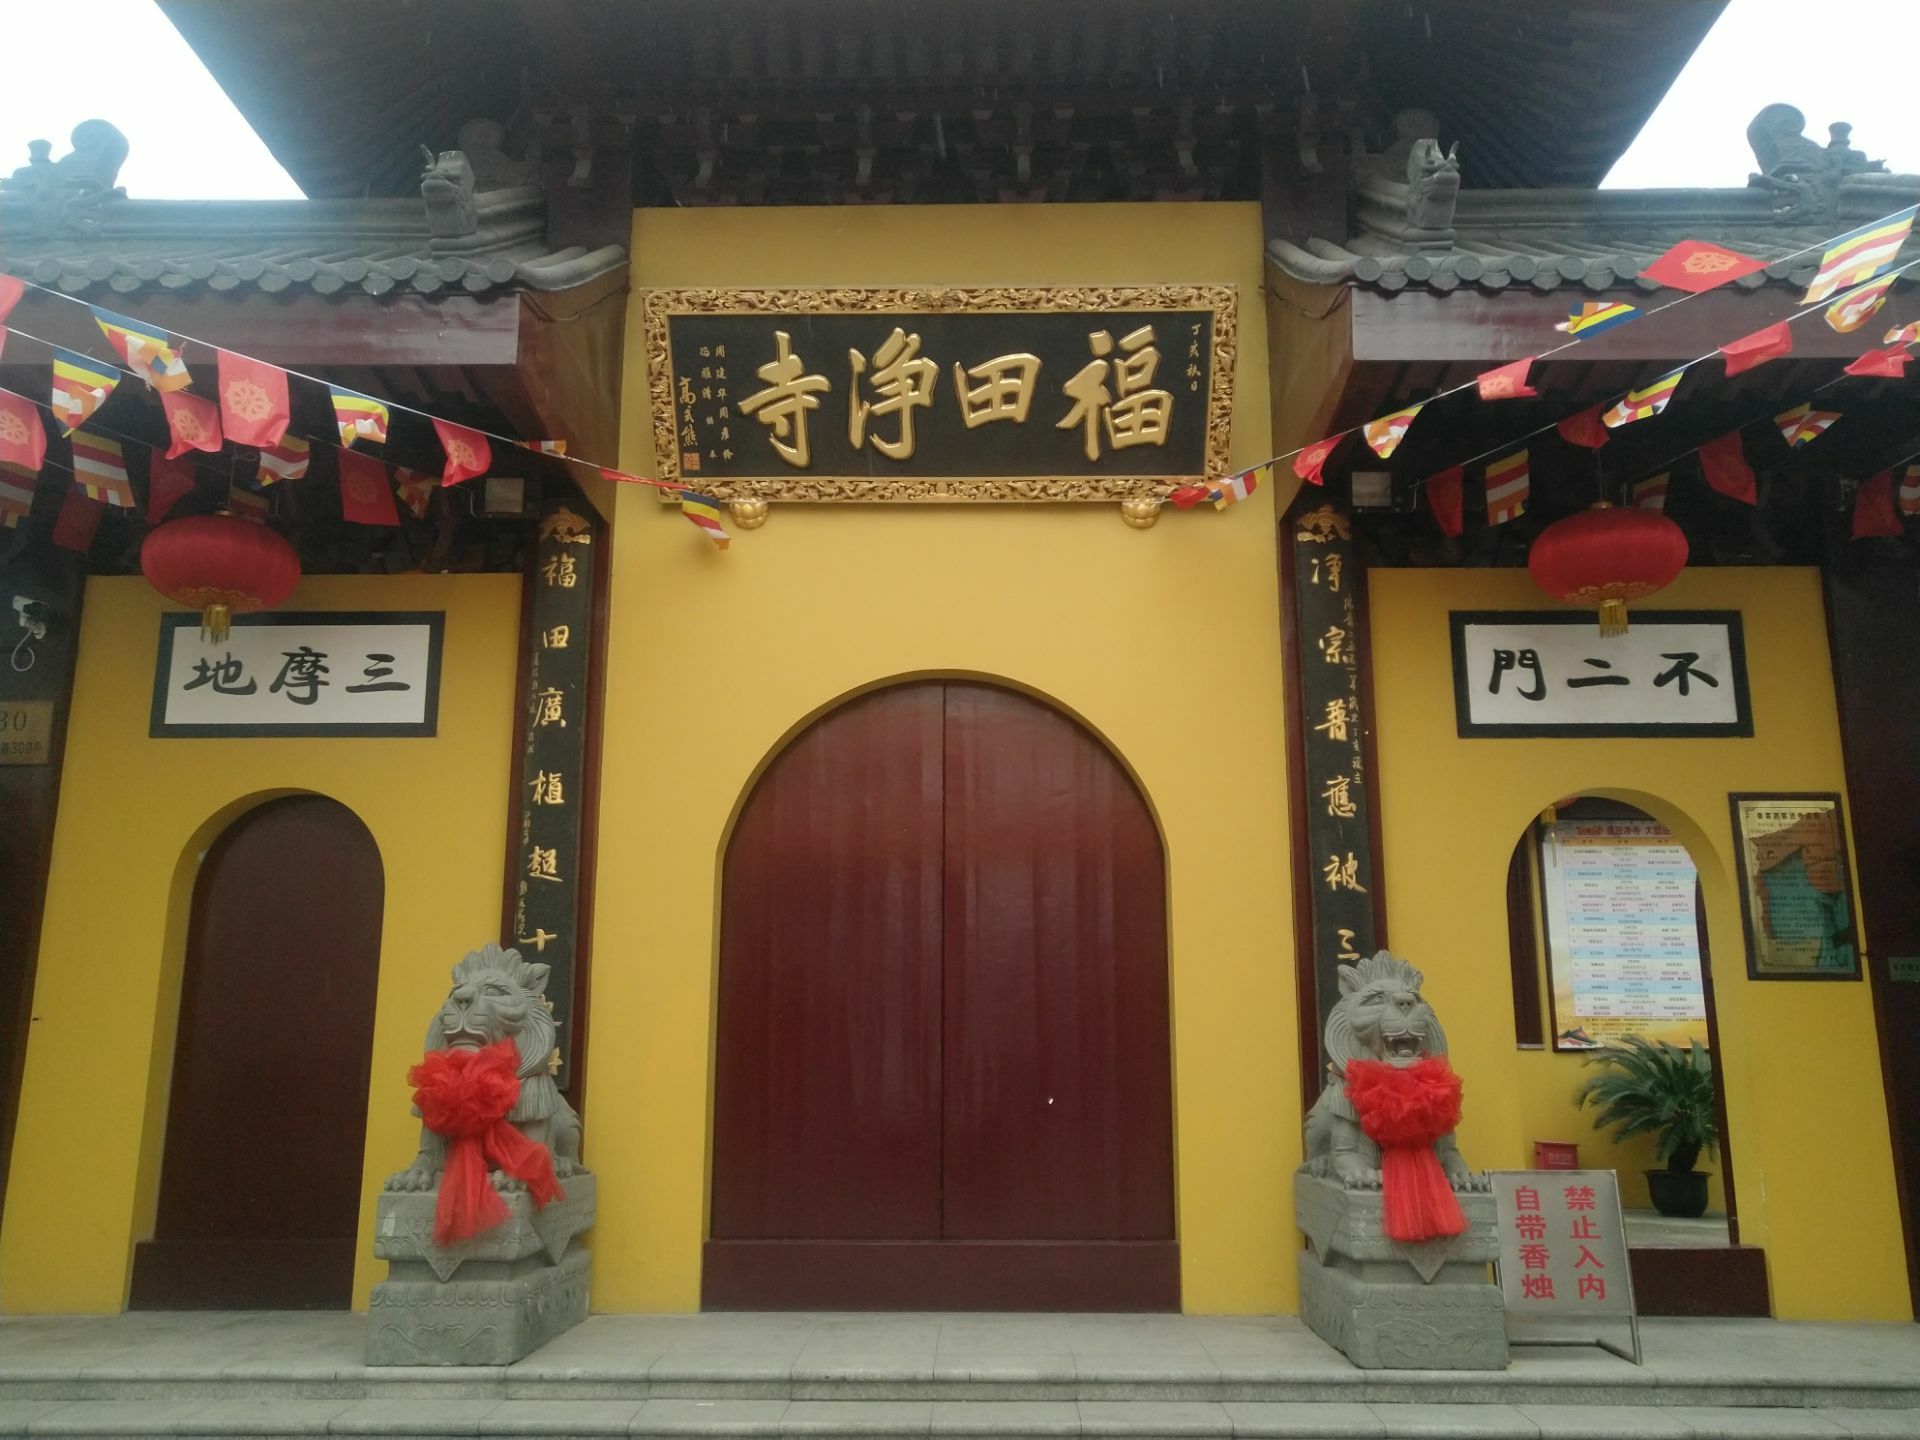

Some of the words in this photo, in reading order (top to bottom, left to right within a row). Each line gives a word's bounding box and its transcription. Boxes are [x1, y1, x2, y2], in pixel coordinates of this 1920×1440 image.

[183, 646, 411, 706] 三摩地
[517, 552, 577, 1027] 福田廣植超十
[1514, 1185, 1556, 1300] 自带香烛
[1564, 1185, 1606, 1300] 禁止入内
